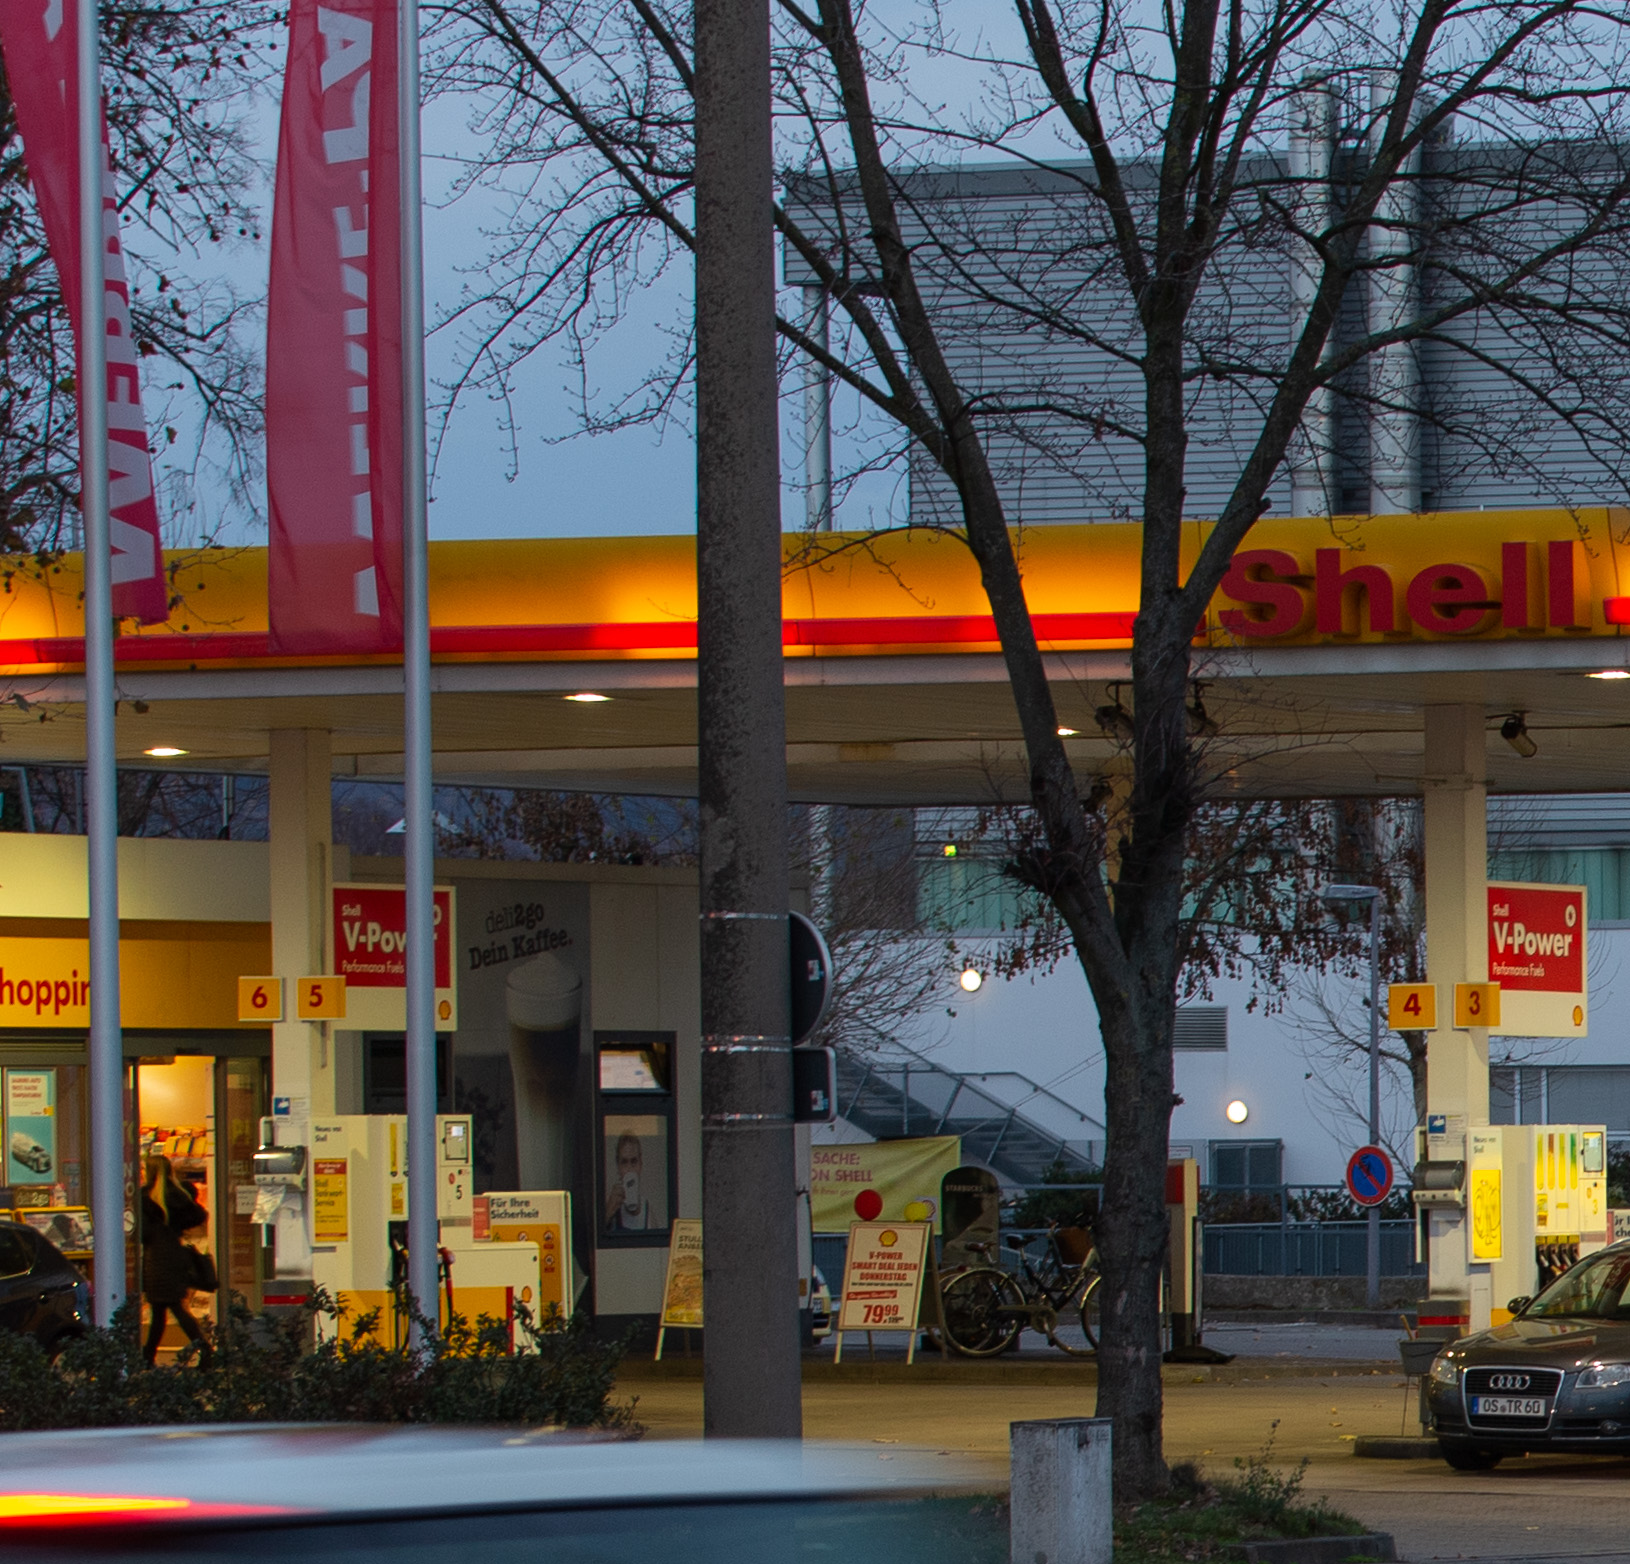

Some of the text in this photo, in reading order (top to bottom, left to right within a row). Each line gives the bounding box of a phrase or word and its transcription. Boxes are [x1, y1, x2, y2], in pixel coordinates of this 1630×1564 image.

[1218, 538, 1575, 638] Shell
[342, 904, 361, 917] Shell
[485, 902, 545, 934] deli2go
[1492, 904, 1509, 917] Shell
[1493, 921, 1573, 957] V-Power
[469, 944, 509, 970] Dein
[342, 960, 405, 974] Performance Fuels
[1492, 962, 1545, 977] Performance Fuels
[251, 985, 268, 1009] 6
[309, 984, 323, 1007] 5
[1468, 990, 1480, 1015] 3
[1403, 993, 1421, 1016] 4
[835, 1170, 873, 1182] SHELL
[456, 1184, 463, 1200] 5
[490, 1198, 530, 1207] Für Ihre
[490, 1208, 539, 1219] Sicherheit
[869, 1251, 903, 1260] V-POWER
[852, 1261, 877, 1270] SMART
[878, 1262, 896, 1270] DEAL
[860, 1272, 907, 1281] DONNERSTAG
[1483, 1399, 1541, 1414] OS TR 60
